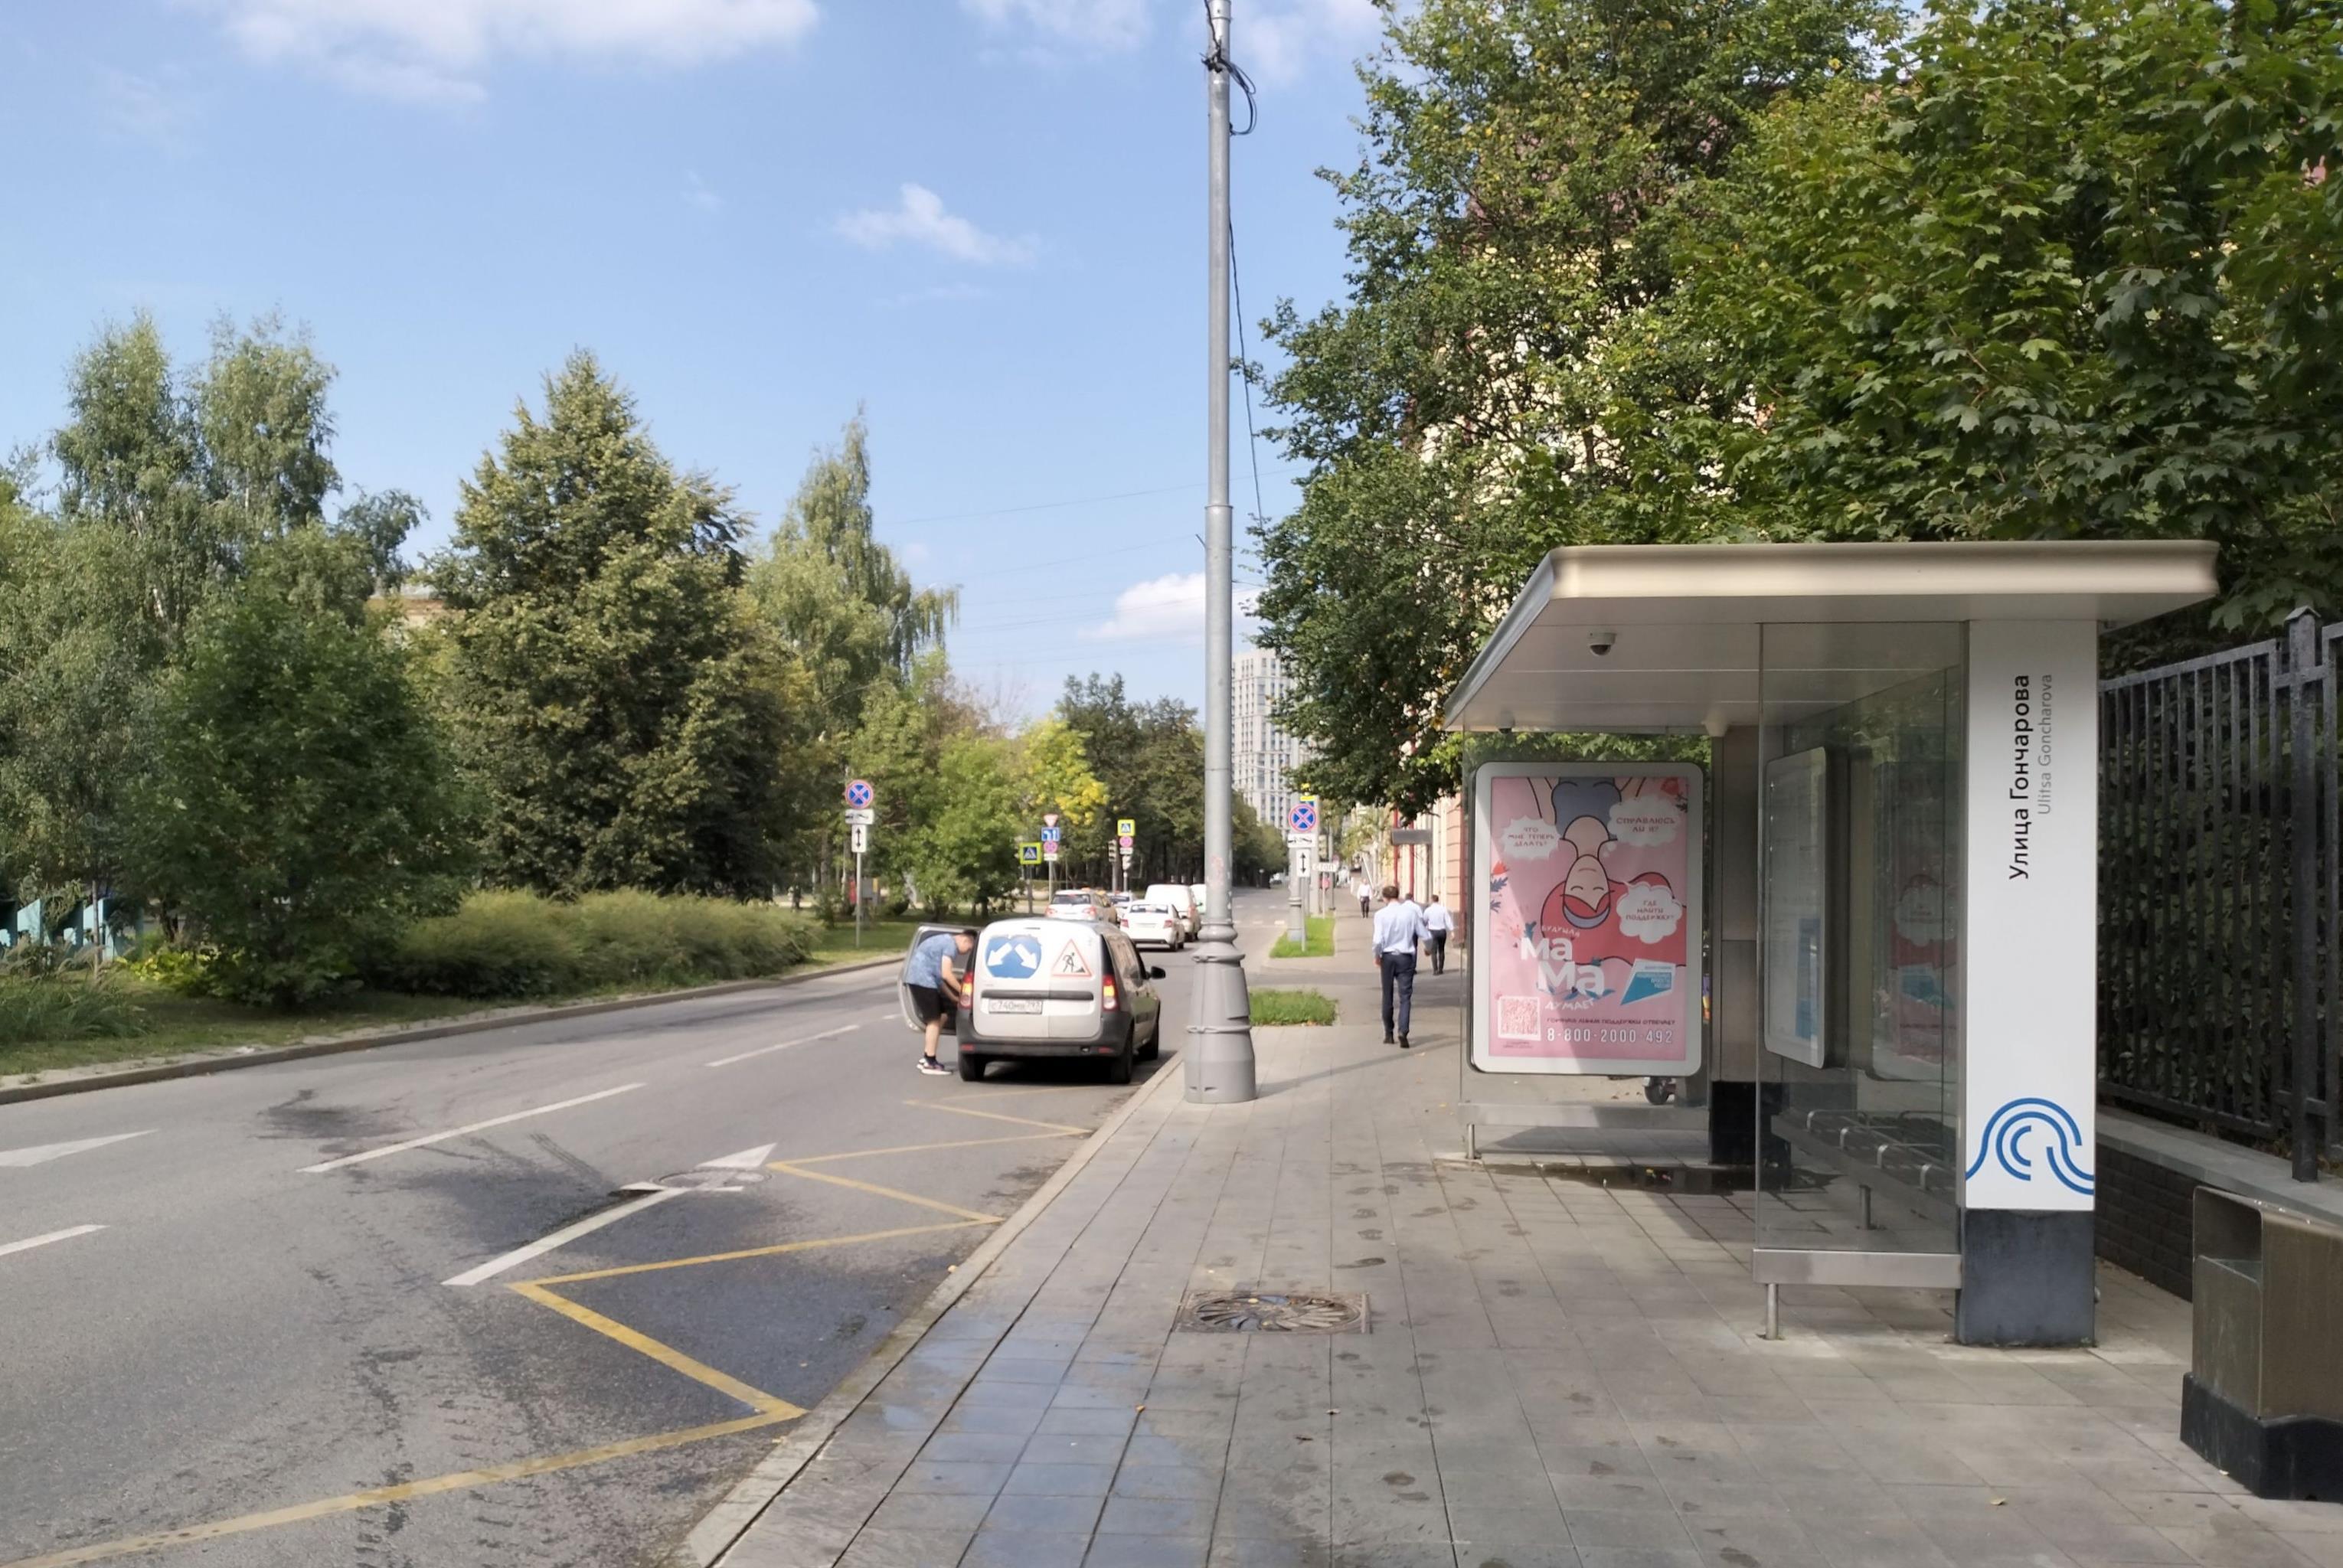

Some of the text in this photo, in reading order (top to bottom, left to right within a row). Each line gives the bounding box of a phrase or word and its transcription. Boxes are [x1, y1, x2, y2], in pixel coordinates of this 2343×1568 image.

[2009, 675, 2034, 880] Улица Гончарова
[2037, 674, 2053, 815] Ulitsa Goncharova
[1545, 998, 1594, 1011] ДУМАЕТ
